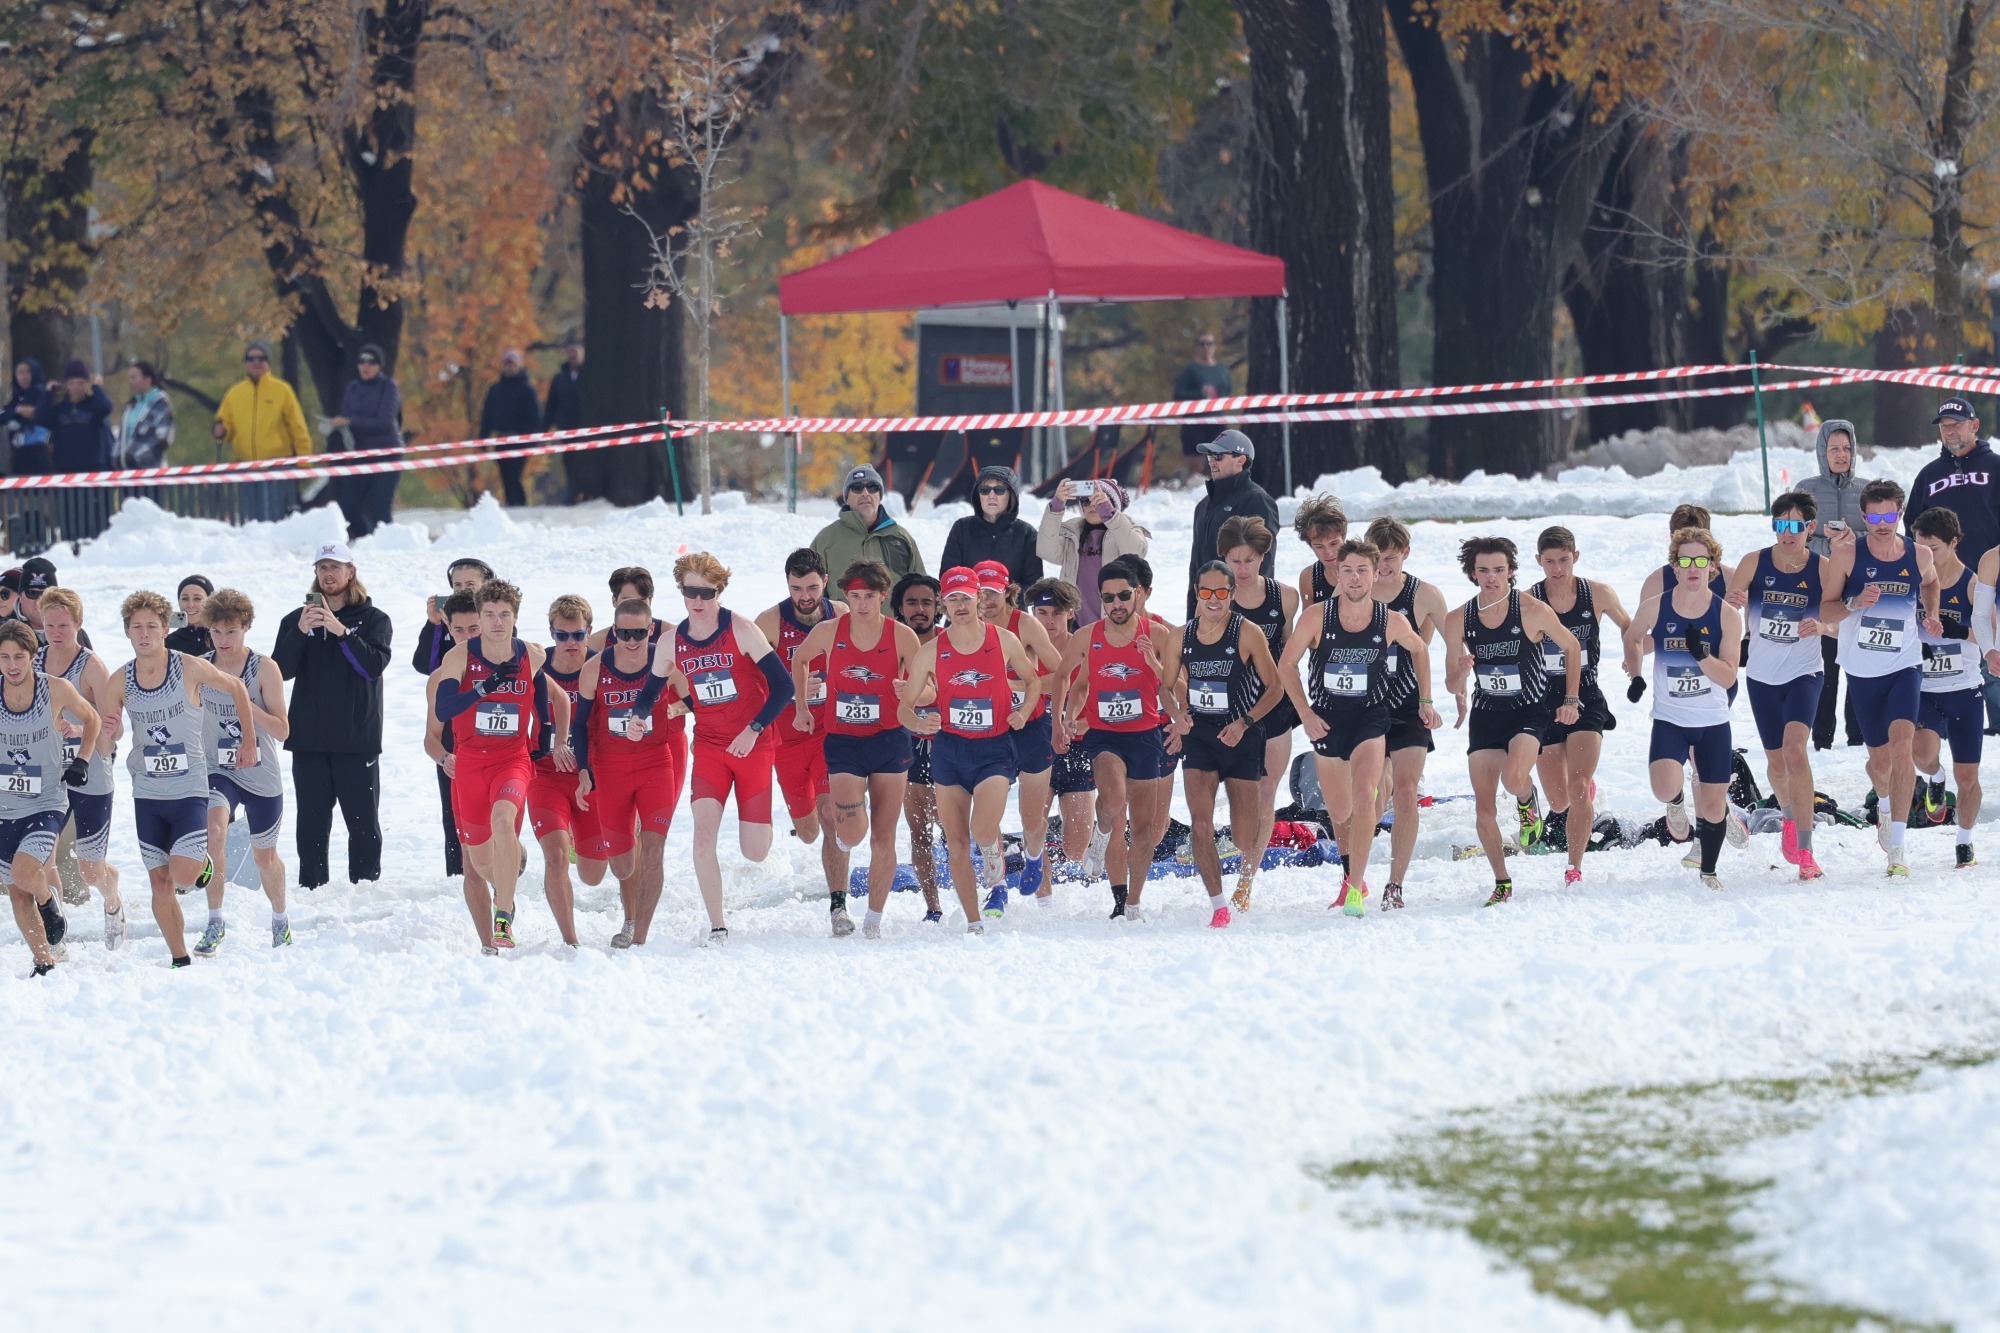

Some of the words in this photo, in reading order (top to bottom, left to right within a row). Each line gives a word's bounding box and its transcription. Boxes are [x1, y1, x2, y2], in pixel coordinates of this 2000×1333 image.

[1939, 402, 1963, 414] DBU
[1929, 472, 1990, 496] DBU
[1867, 582, 1909, 596] EGIS
[1768, 622, 1791, 637] 272
[1869, 630, 1892, 646] 278
[1327, 648, 1379, 664] BHSU
[1475, 639, 1521, 659] BHSU
[681, 653, 733, 676] DBU
[1189, 660, 1234, 677] BHSU
[1930, 657, 1952, 671] 274
[472, 679, 527, 694] BU
[705, 683, 723, 698] 177
[1336, 676, 1353, 690] 43
[1489, 677, 1507, 690] 39
[1677, 678, 1700, 692] 273
[1199, 694, 1214, 707] 44
[146, 708, 166, 723] DAKOTA
[167, 700, 184, 719] MINES
[845, 705, 870, 719] 233
[1107, 702, 1133, 717] 232
[487, 716, 507, 730] 176
[958, 711, 983, 725] 229
[32, 726, 49, 744] MINES
[153, 756, 178, 772] 292
[8, 777, 31, 792] 291
